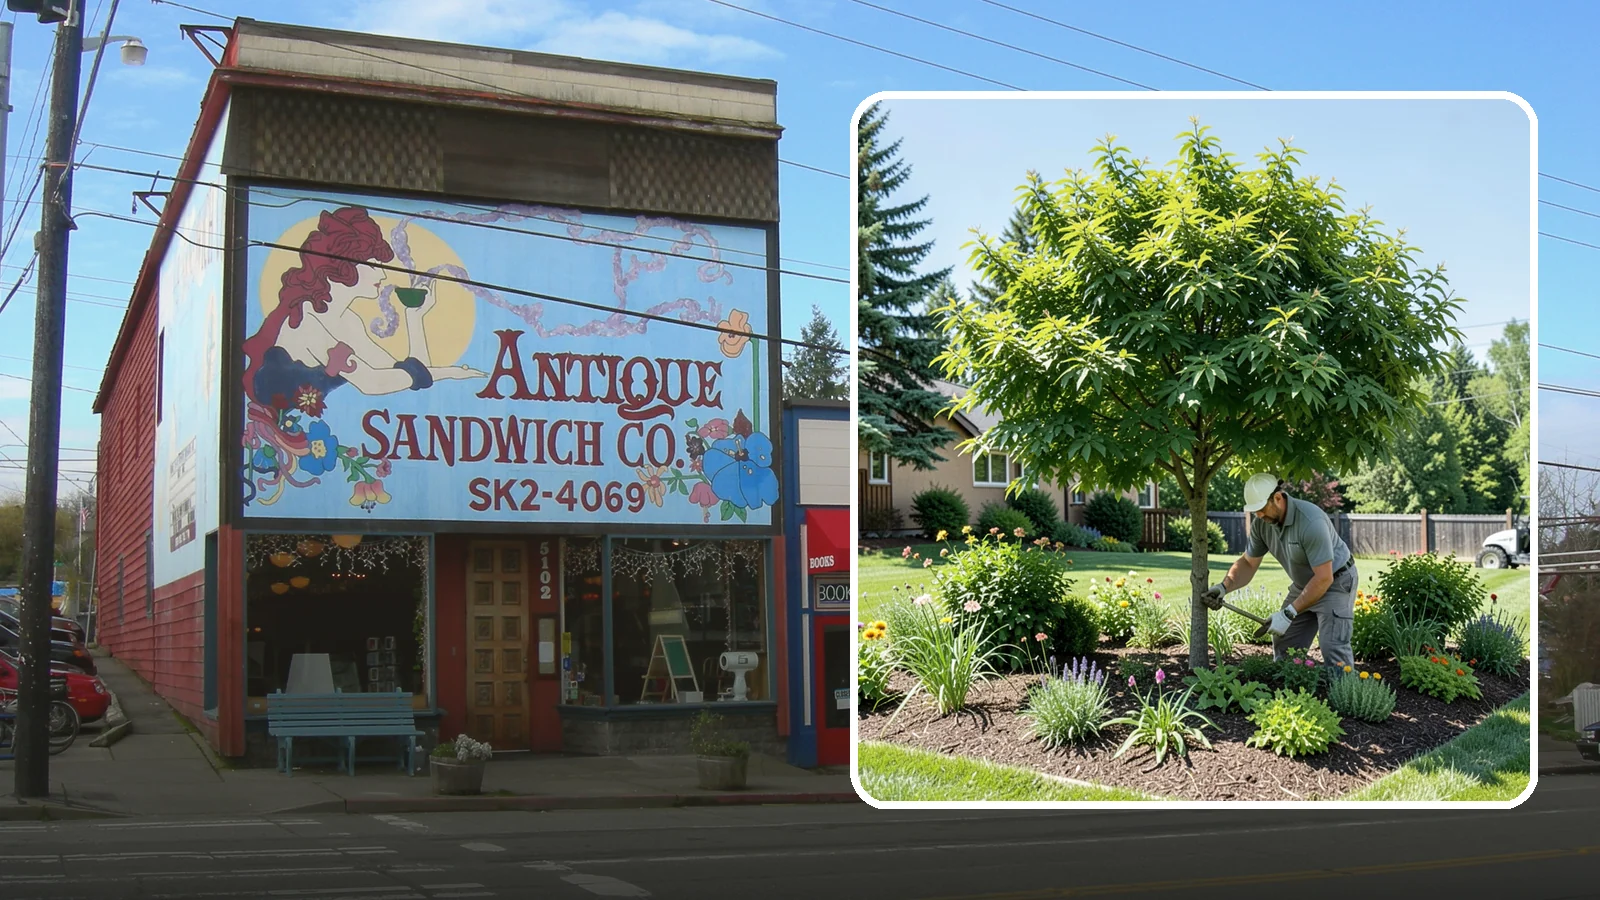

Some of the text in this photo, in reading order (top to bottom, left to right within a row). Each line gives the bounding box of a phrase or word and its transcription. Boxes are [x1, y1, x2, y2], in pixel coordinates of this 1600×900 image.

[476, 329, 724, 420] ANTIQUE
[362, 409, 685, 469] SANDWICH CO.
[468, 477, 646, 513] SK2-4069
[540, 541, 551, 600] 5102
[810, 555, 835, 569] BOOKS
